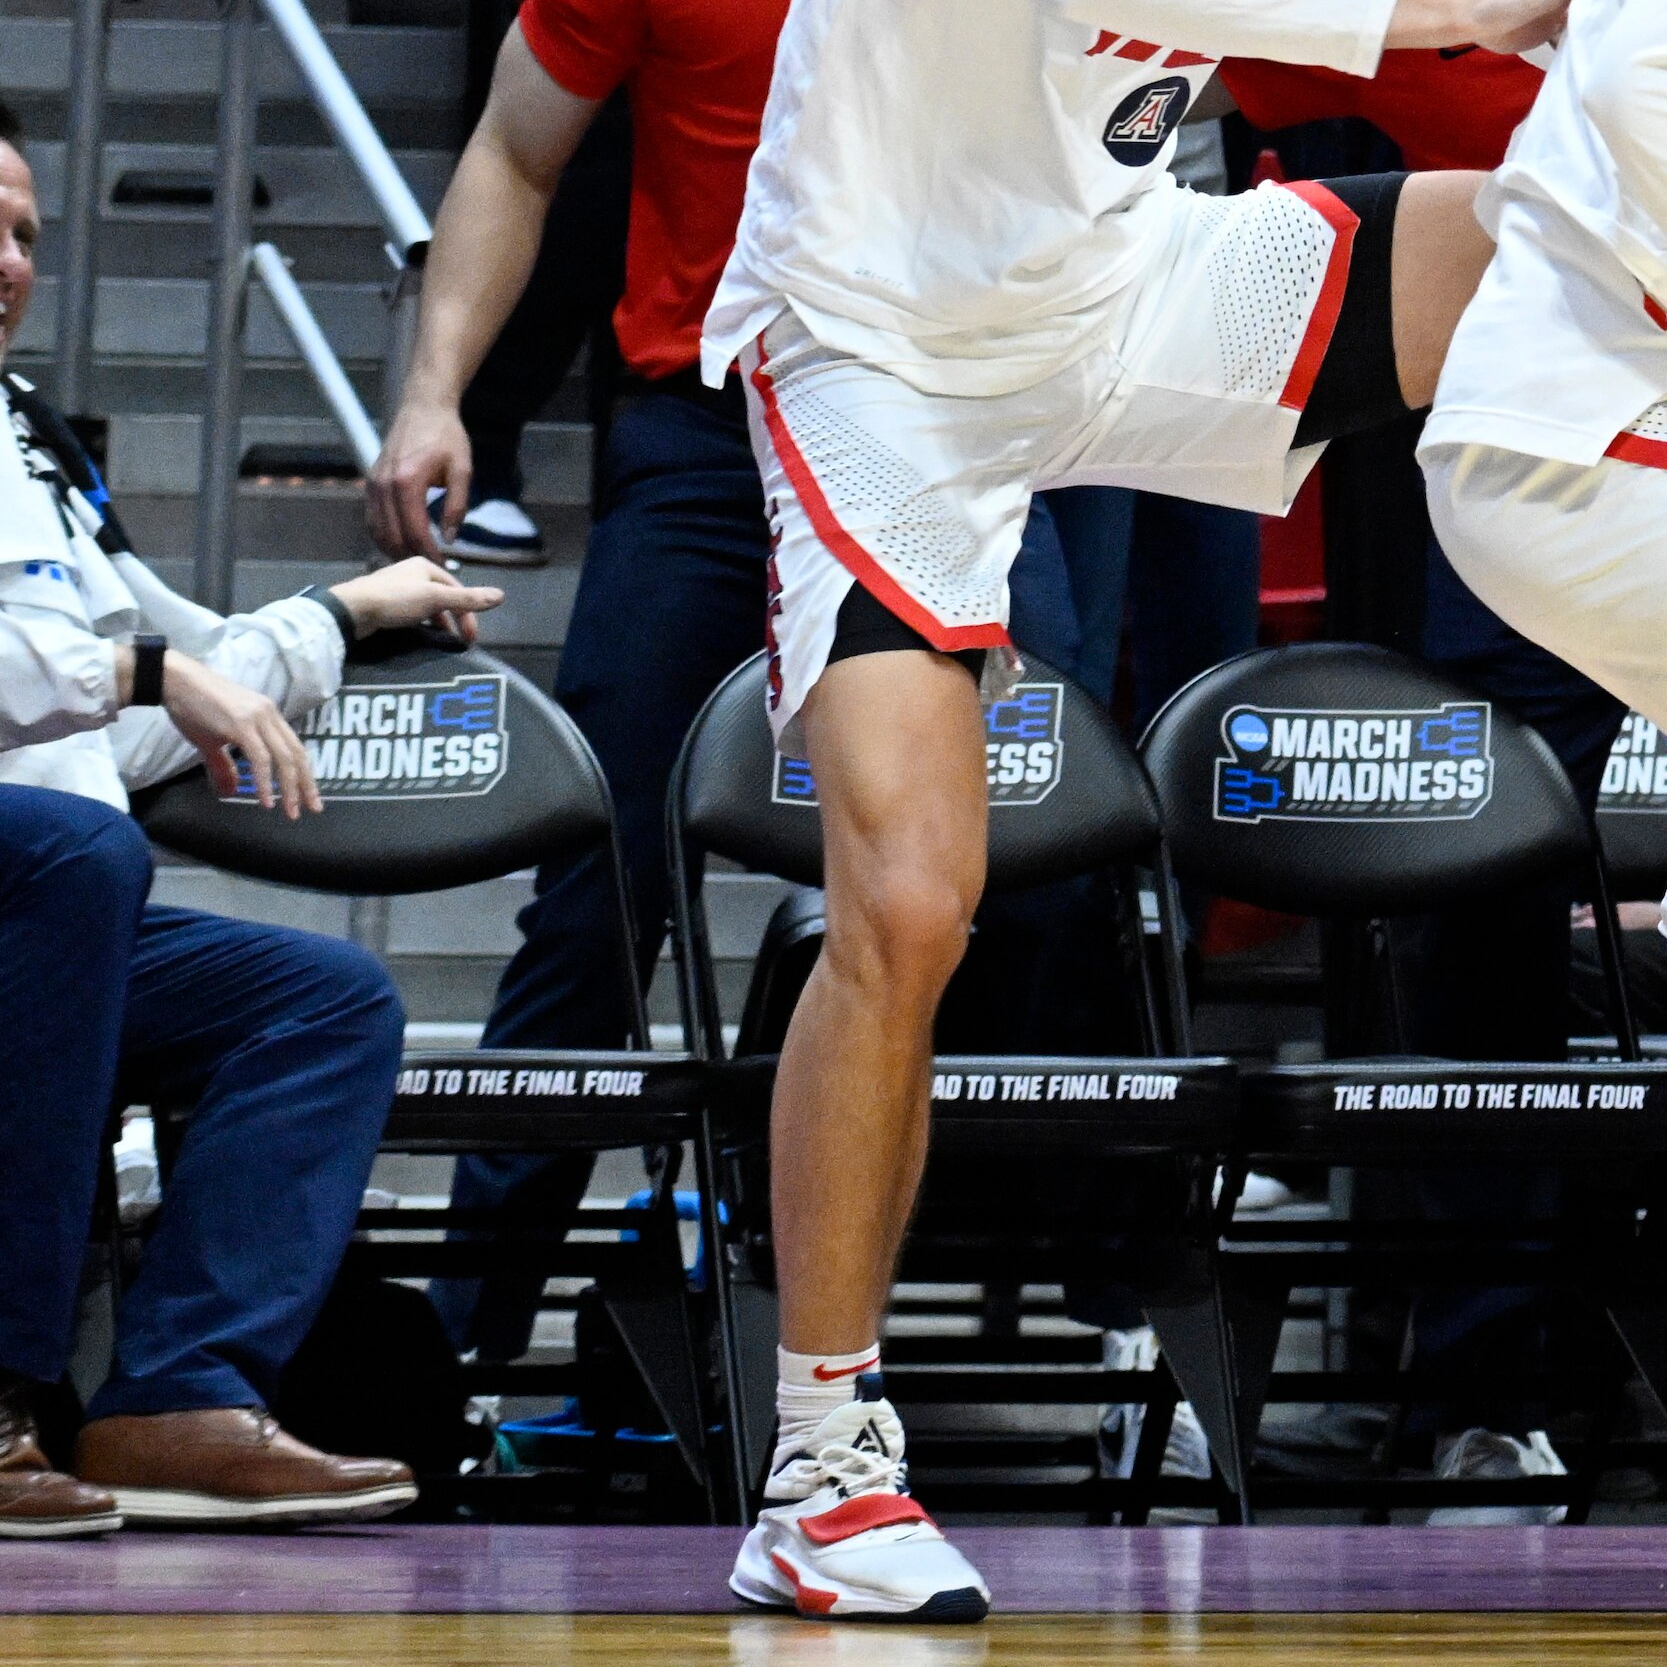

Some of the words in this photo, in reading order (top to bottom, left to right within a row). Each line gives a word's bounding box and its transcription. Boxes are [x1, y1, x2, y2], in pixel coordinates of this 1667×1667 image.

[1107, 87, 1180, 143] A
[306, 694, 426, 736] ARCH
[308, 732, 500, 780] MADNESS
[1271, 718, 1412, 760] MARCH
[1292, 758, 1487, 803] MADNESS
[433, 1069, 463, 1095] TO
[467, 1069, 511, 1096] THE
[512, 1070, 577, 1096] FINAL
[582, 1070, 645, 1096] FOUR
[966, 1074, 996, 1101] TO
[1000, 1075, 1045, 1101] THE
[1046, 1074, 1111, 1100] FINAL
[1116, 1075, 1179, 1101] FOUR
[1333, 1085, 1376, 1111] THE
[1379, 1085, 1440, 1110] ROAD
[1443, 1084, 1471, 1110] TO
[1476, 1084, 1518, 1110] THE
[1520, 1084, 1581, 1109] FINAL
[1587, 1085, 1646, 1110] FOUR
